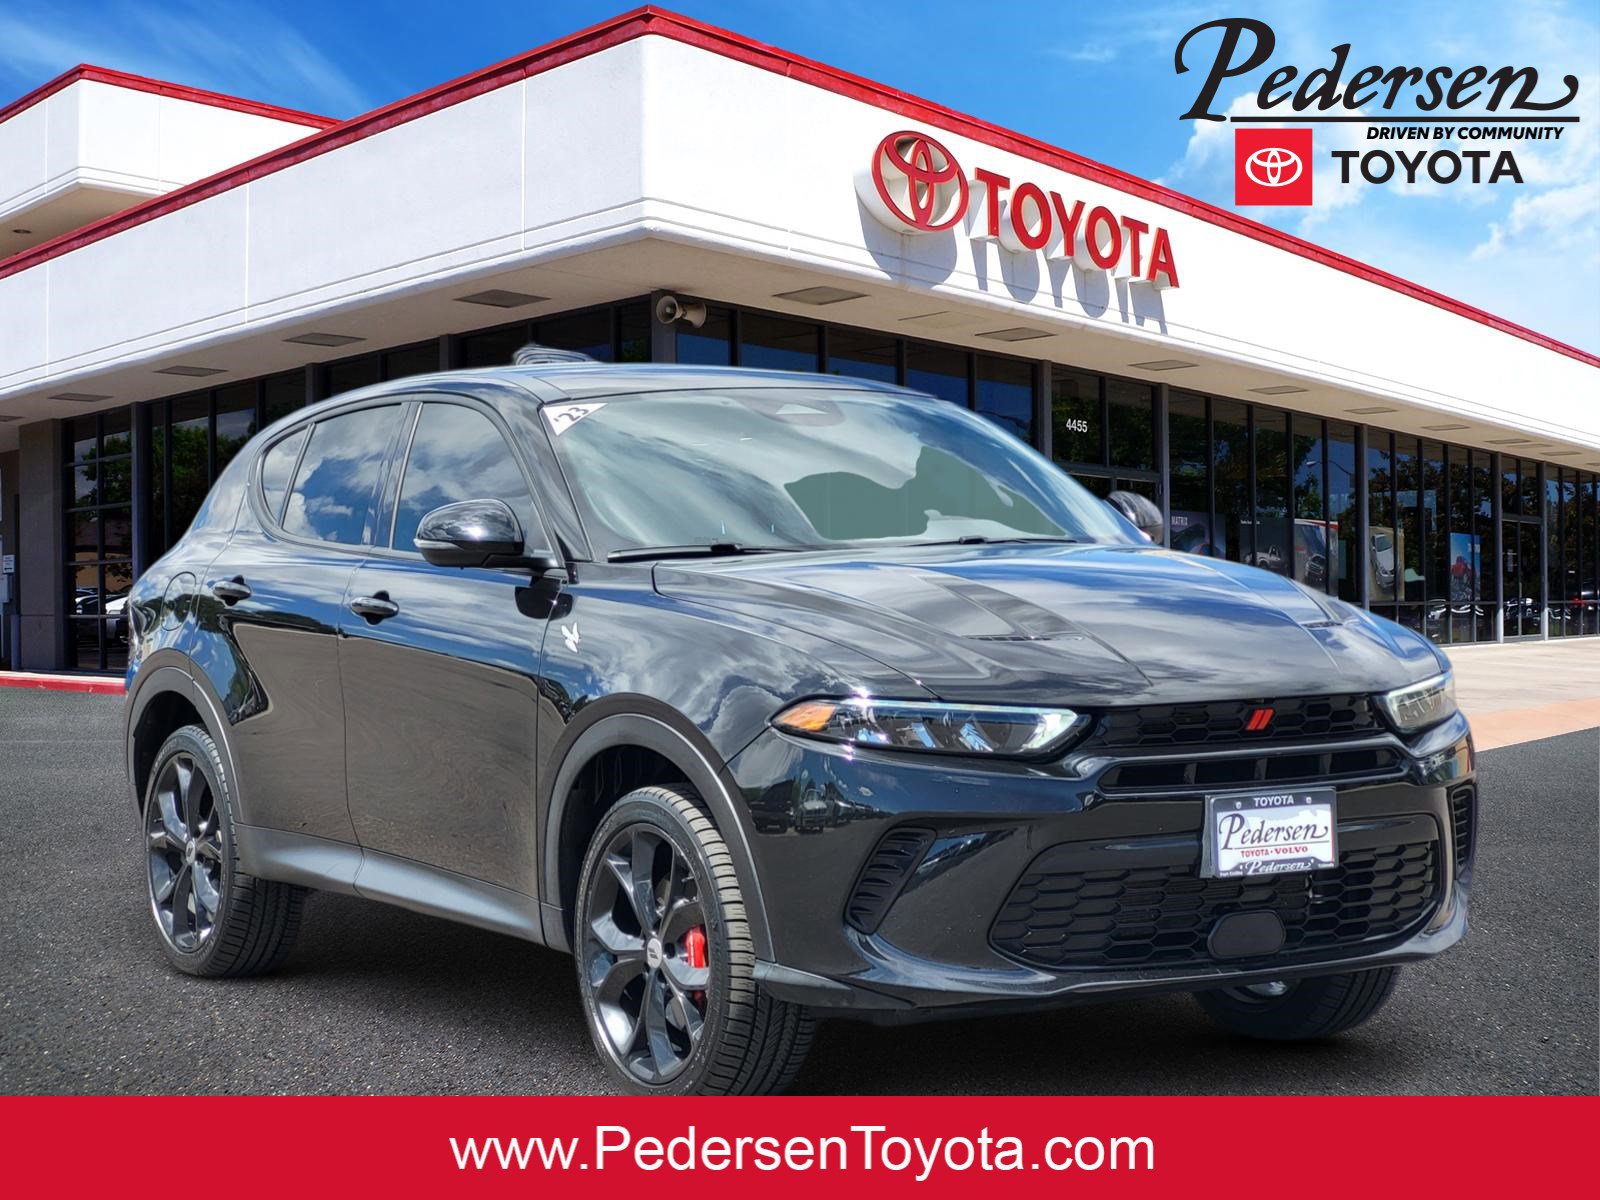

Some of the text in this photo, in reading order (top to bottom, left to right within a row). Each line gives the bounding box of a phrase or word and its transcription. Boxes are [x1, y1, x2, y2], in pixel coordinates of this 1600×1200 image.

[974, 166, 1180, 289] TOYOTA
[1065, 418, 1088, 433] 4455
[1253, 795, 1295, 807] TOYOTA
[1218, 812, 1329, 850] Pedersen
[1241, 846, 1309, 858] TOYOTA VOLVO
[1244, 860, 1313, 876] Pedersen
